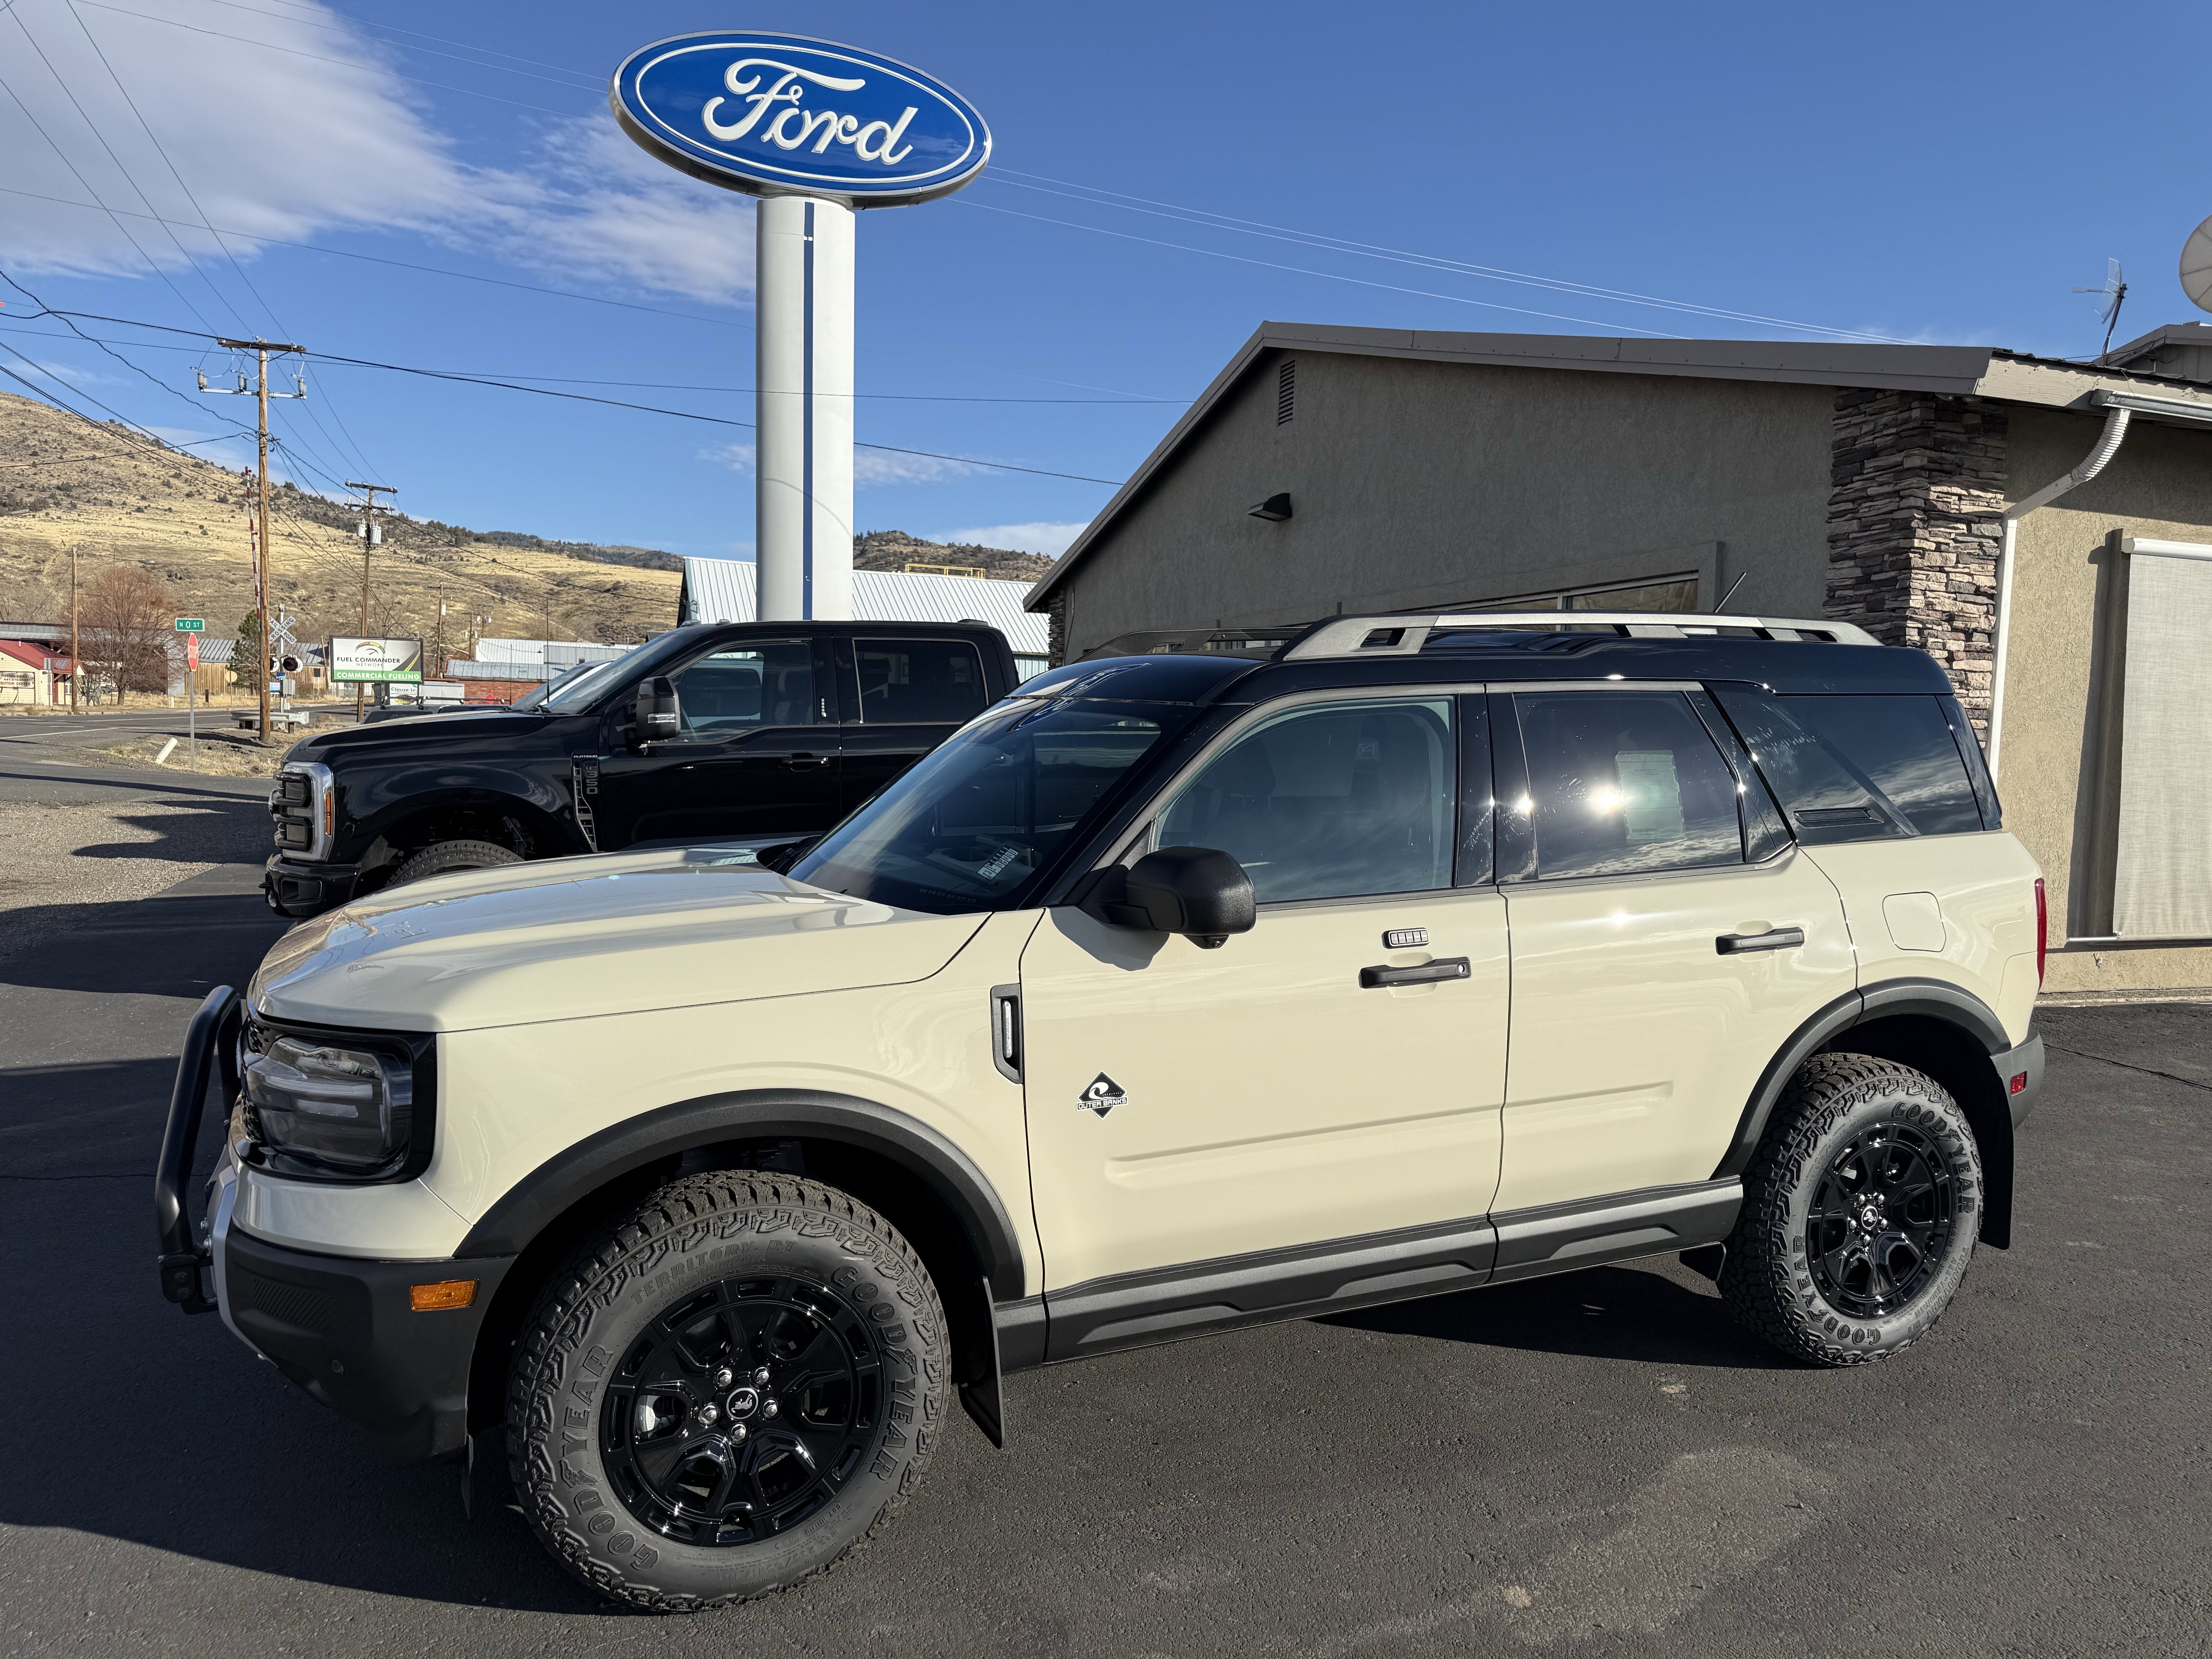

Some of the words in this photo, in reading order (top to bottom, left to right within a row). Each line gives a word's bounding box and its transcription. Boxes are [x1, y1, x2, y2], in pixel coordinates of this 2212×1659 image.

[701, 58, 919, 165] Ford
[188, 645, 199, 659] STOP
[283, 632, 295, 642] ROAD
[1078, 1101, 1101, 1109] OUTER
[1103, 1098, 1127, 1106] BANKS
[1891, 1101, 1976, 1214] GOODYEAR
[631, 1240, 754, 1305] TERRITORY
[766, 1240, 798, 1253] RT
[1793, 1233, 1881, 1346] GOODYEAR
[831, 1265, 918, 1481] GOODYEAR
[560, 1344, 659, 1571] GOODYEAR
